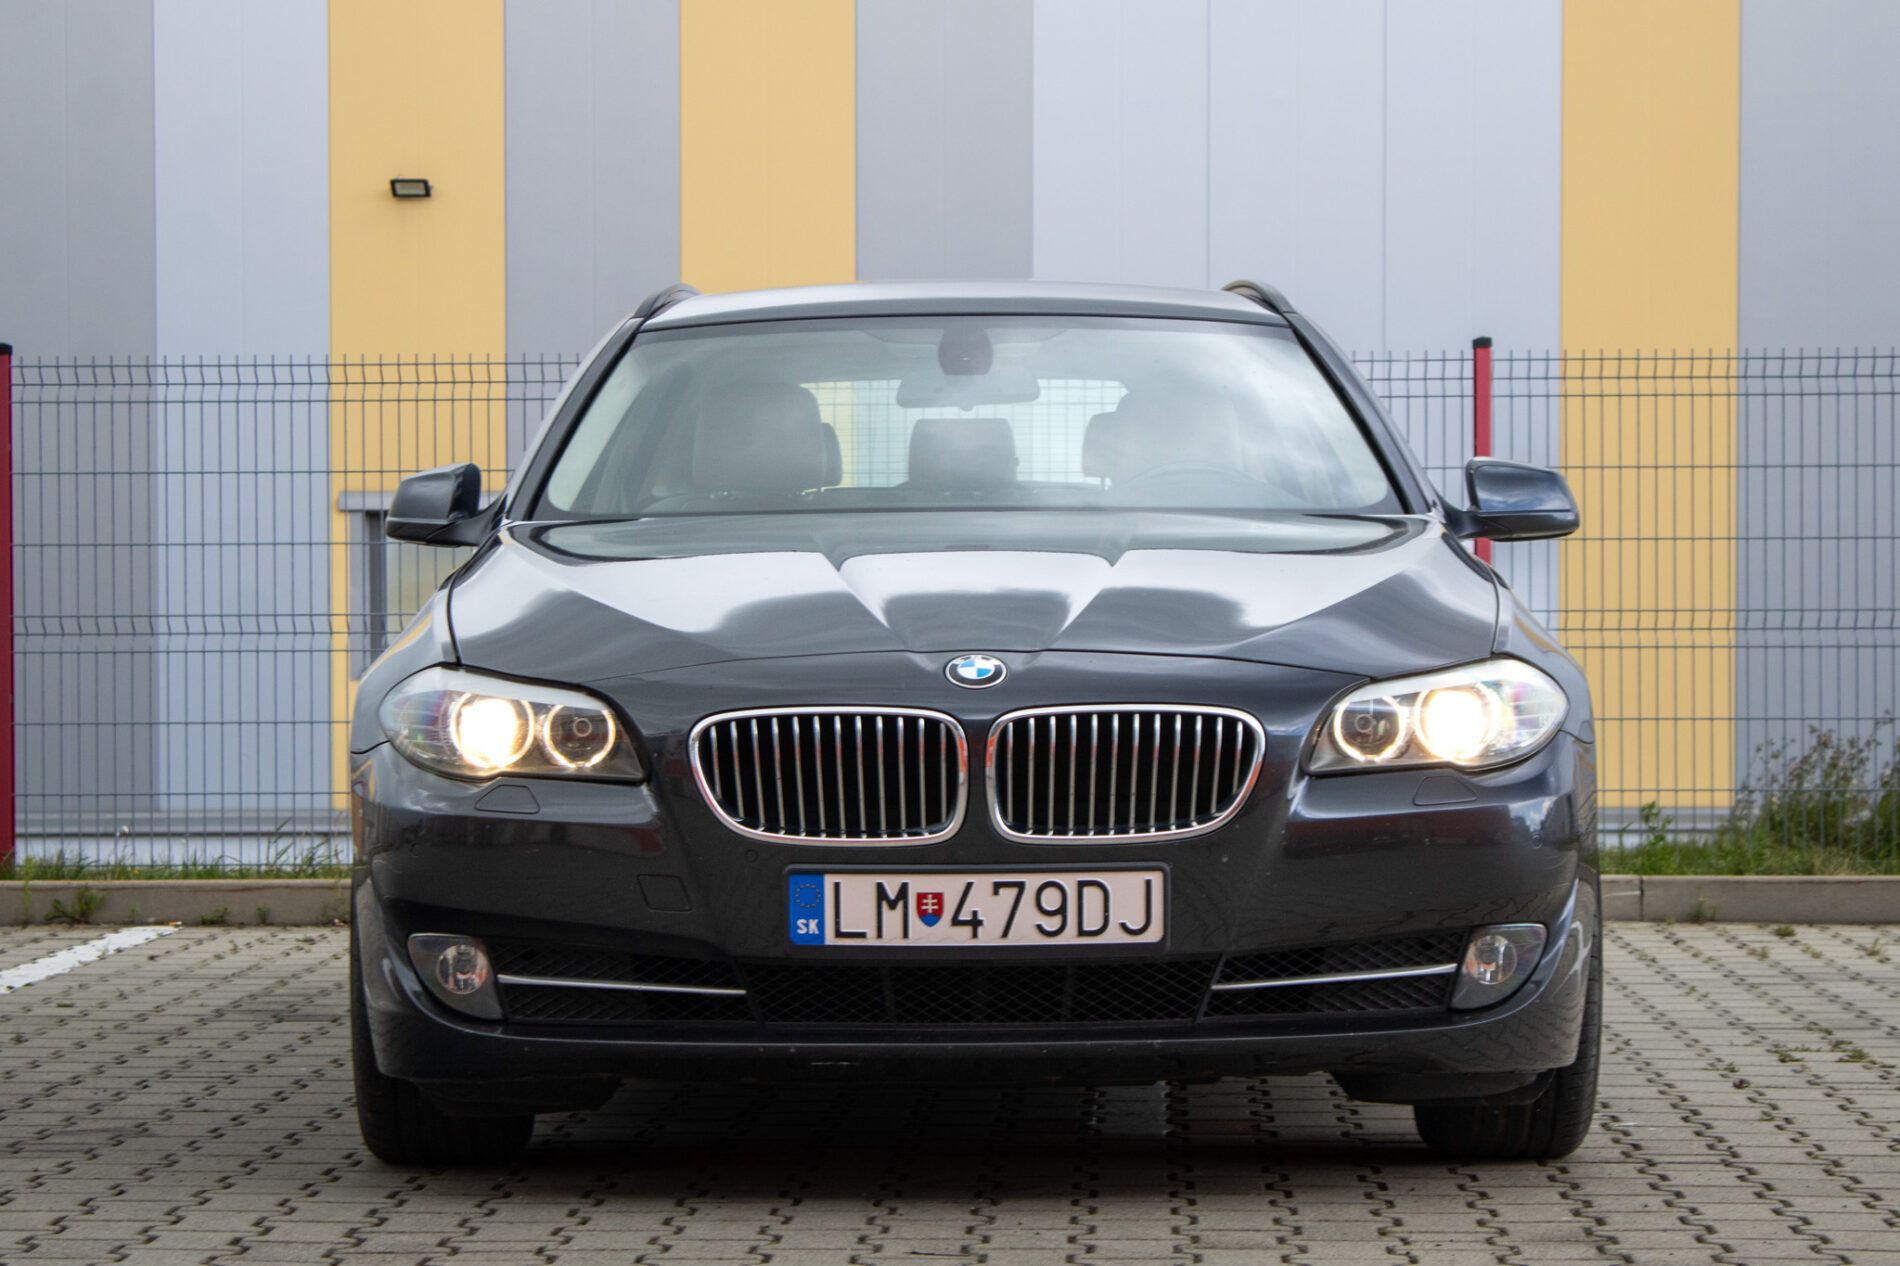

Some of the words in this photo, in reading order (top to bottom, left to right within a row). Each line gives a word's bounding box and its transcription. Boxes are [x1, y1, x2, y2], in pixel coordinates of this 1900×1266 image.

[796, 918, 820, 935] SK
[833, 880, 910, 940] LM
[951, 878, 1154, 940] 479DJ
